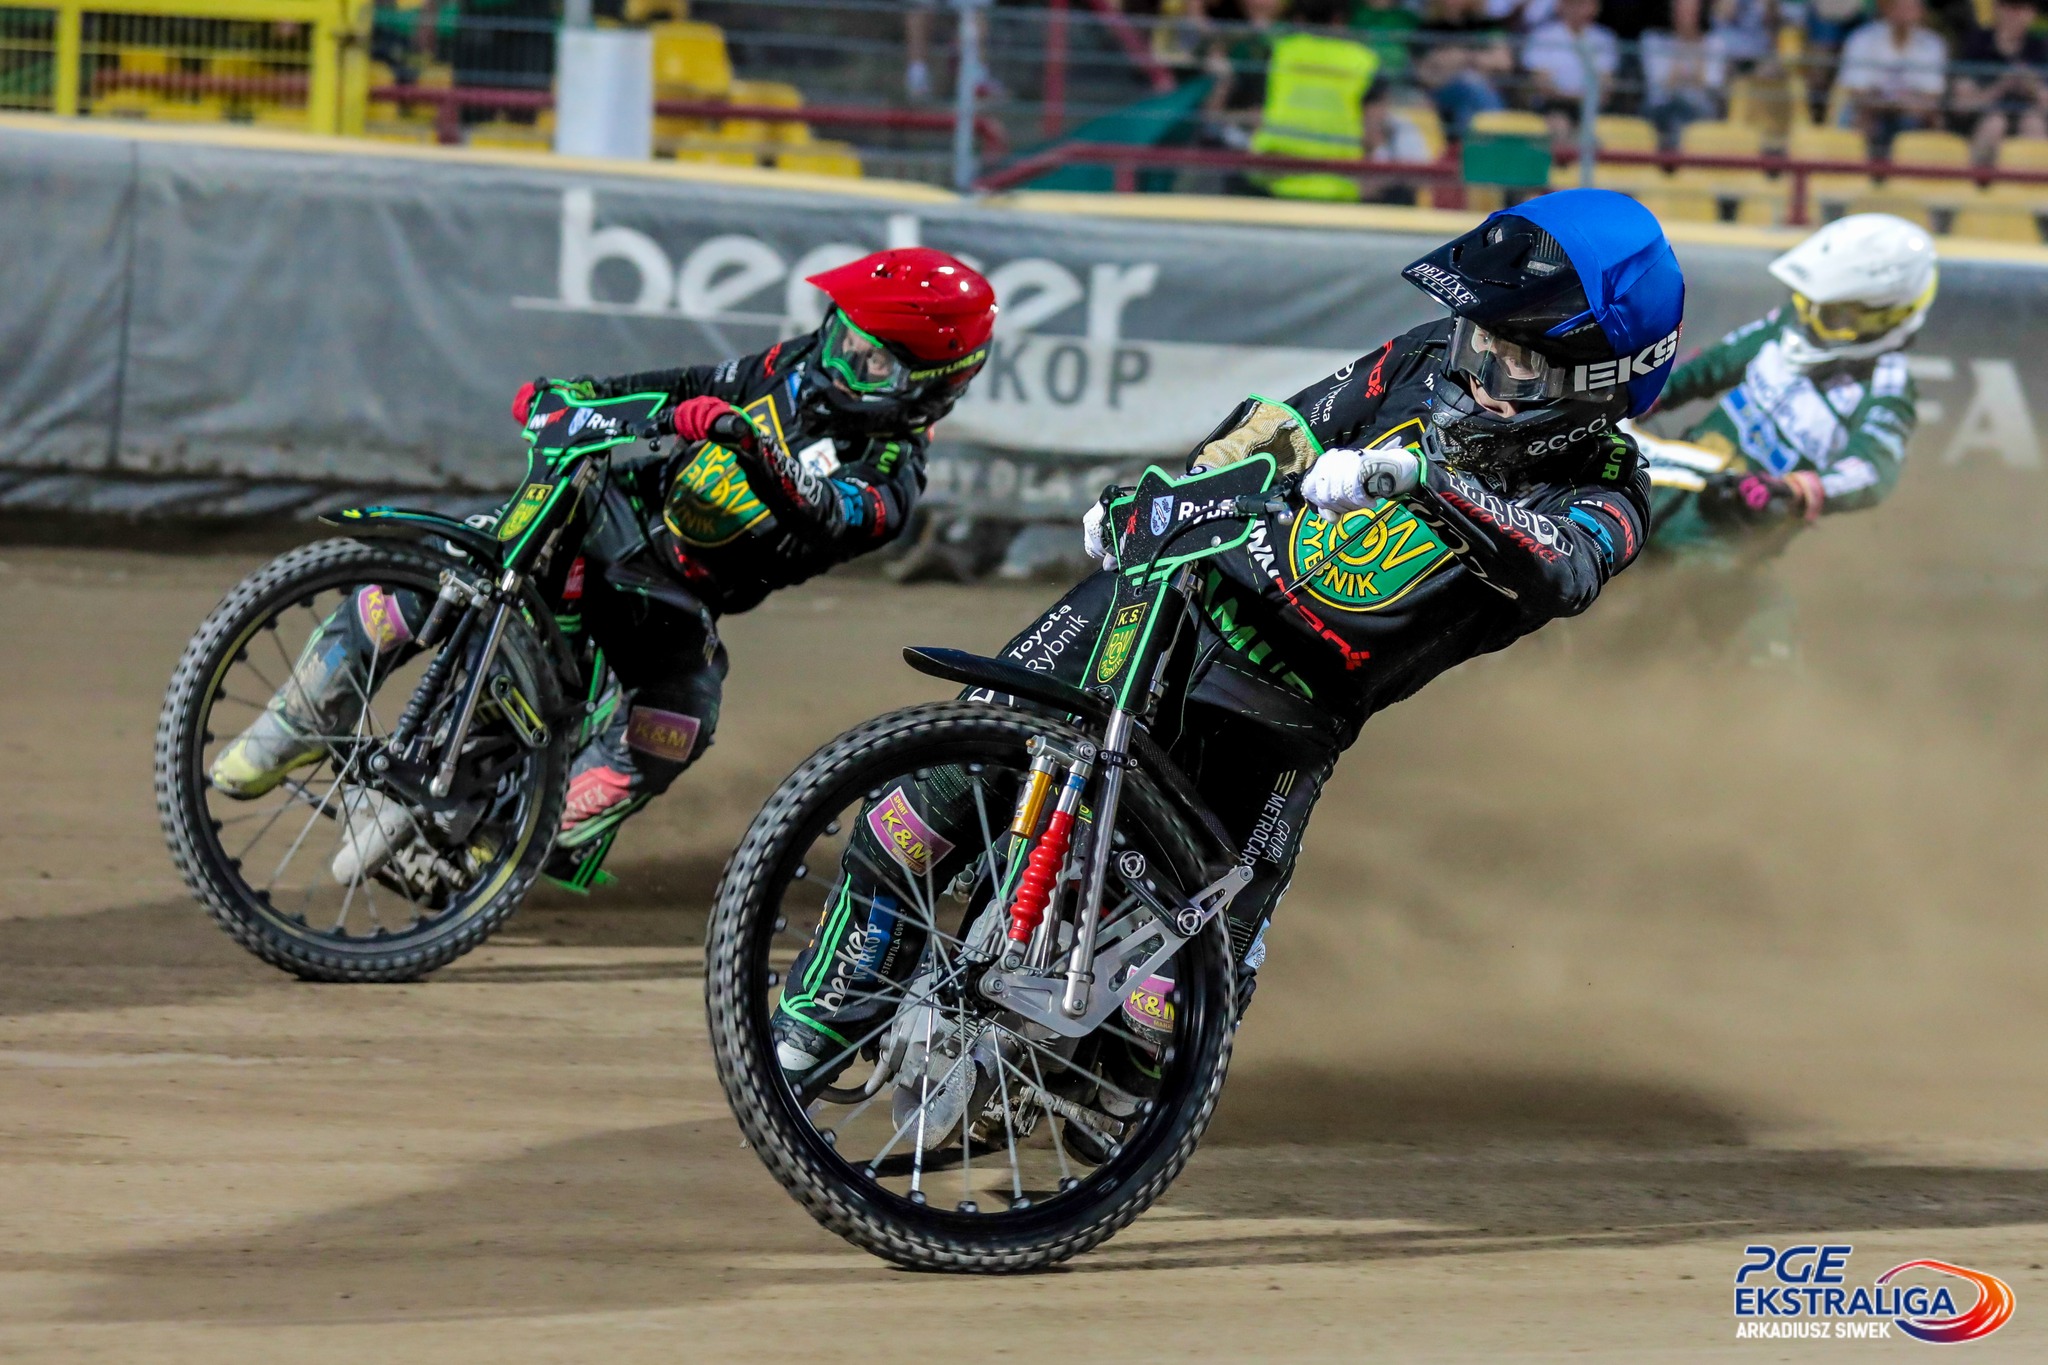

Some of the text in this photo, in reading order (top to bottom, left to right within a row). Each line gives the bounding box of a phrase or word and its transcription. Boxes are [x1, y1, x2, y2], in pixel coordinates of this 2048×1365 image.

[558, 187, 1160, 342] becer
[1412, 263, 1474, 304] DELUXE
[1527, 415, 1606, 457] ecco
[1008, 604, 1073, 661] Toyota
[1025, 614, 1090, 671] Rybnik
[893, 795, 909, 816] SPORT
[880, 808, 932, 863] K&M
[1262, 818, 1291, 864] GRUPA
[813, 920, 869, 1013] becker
